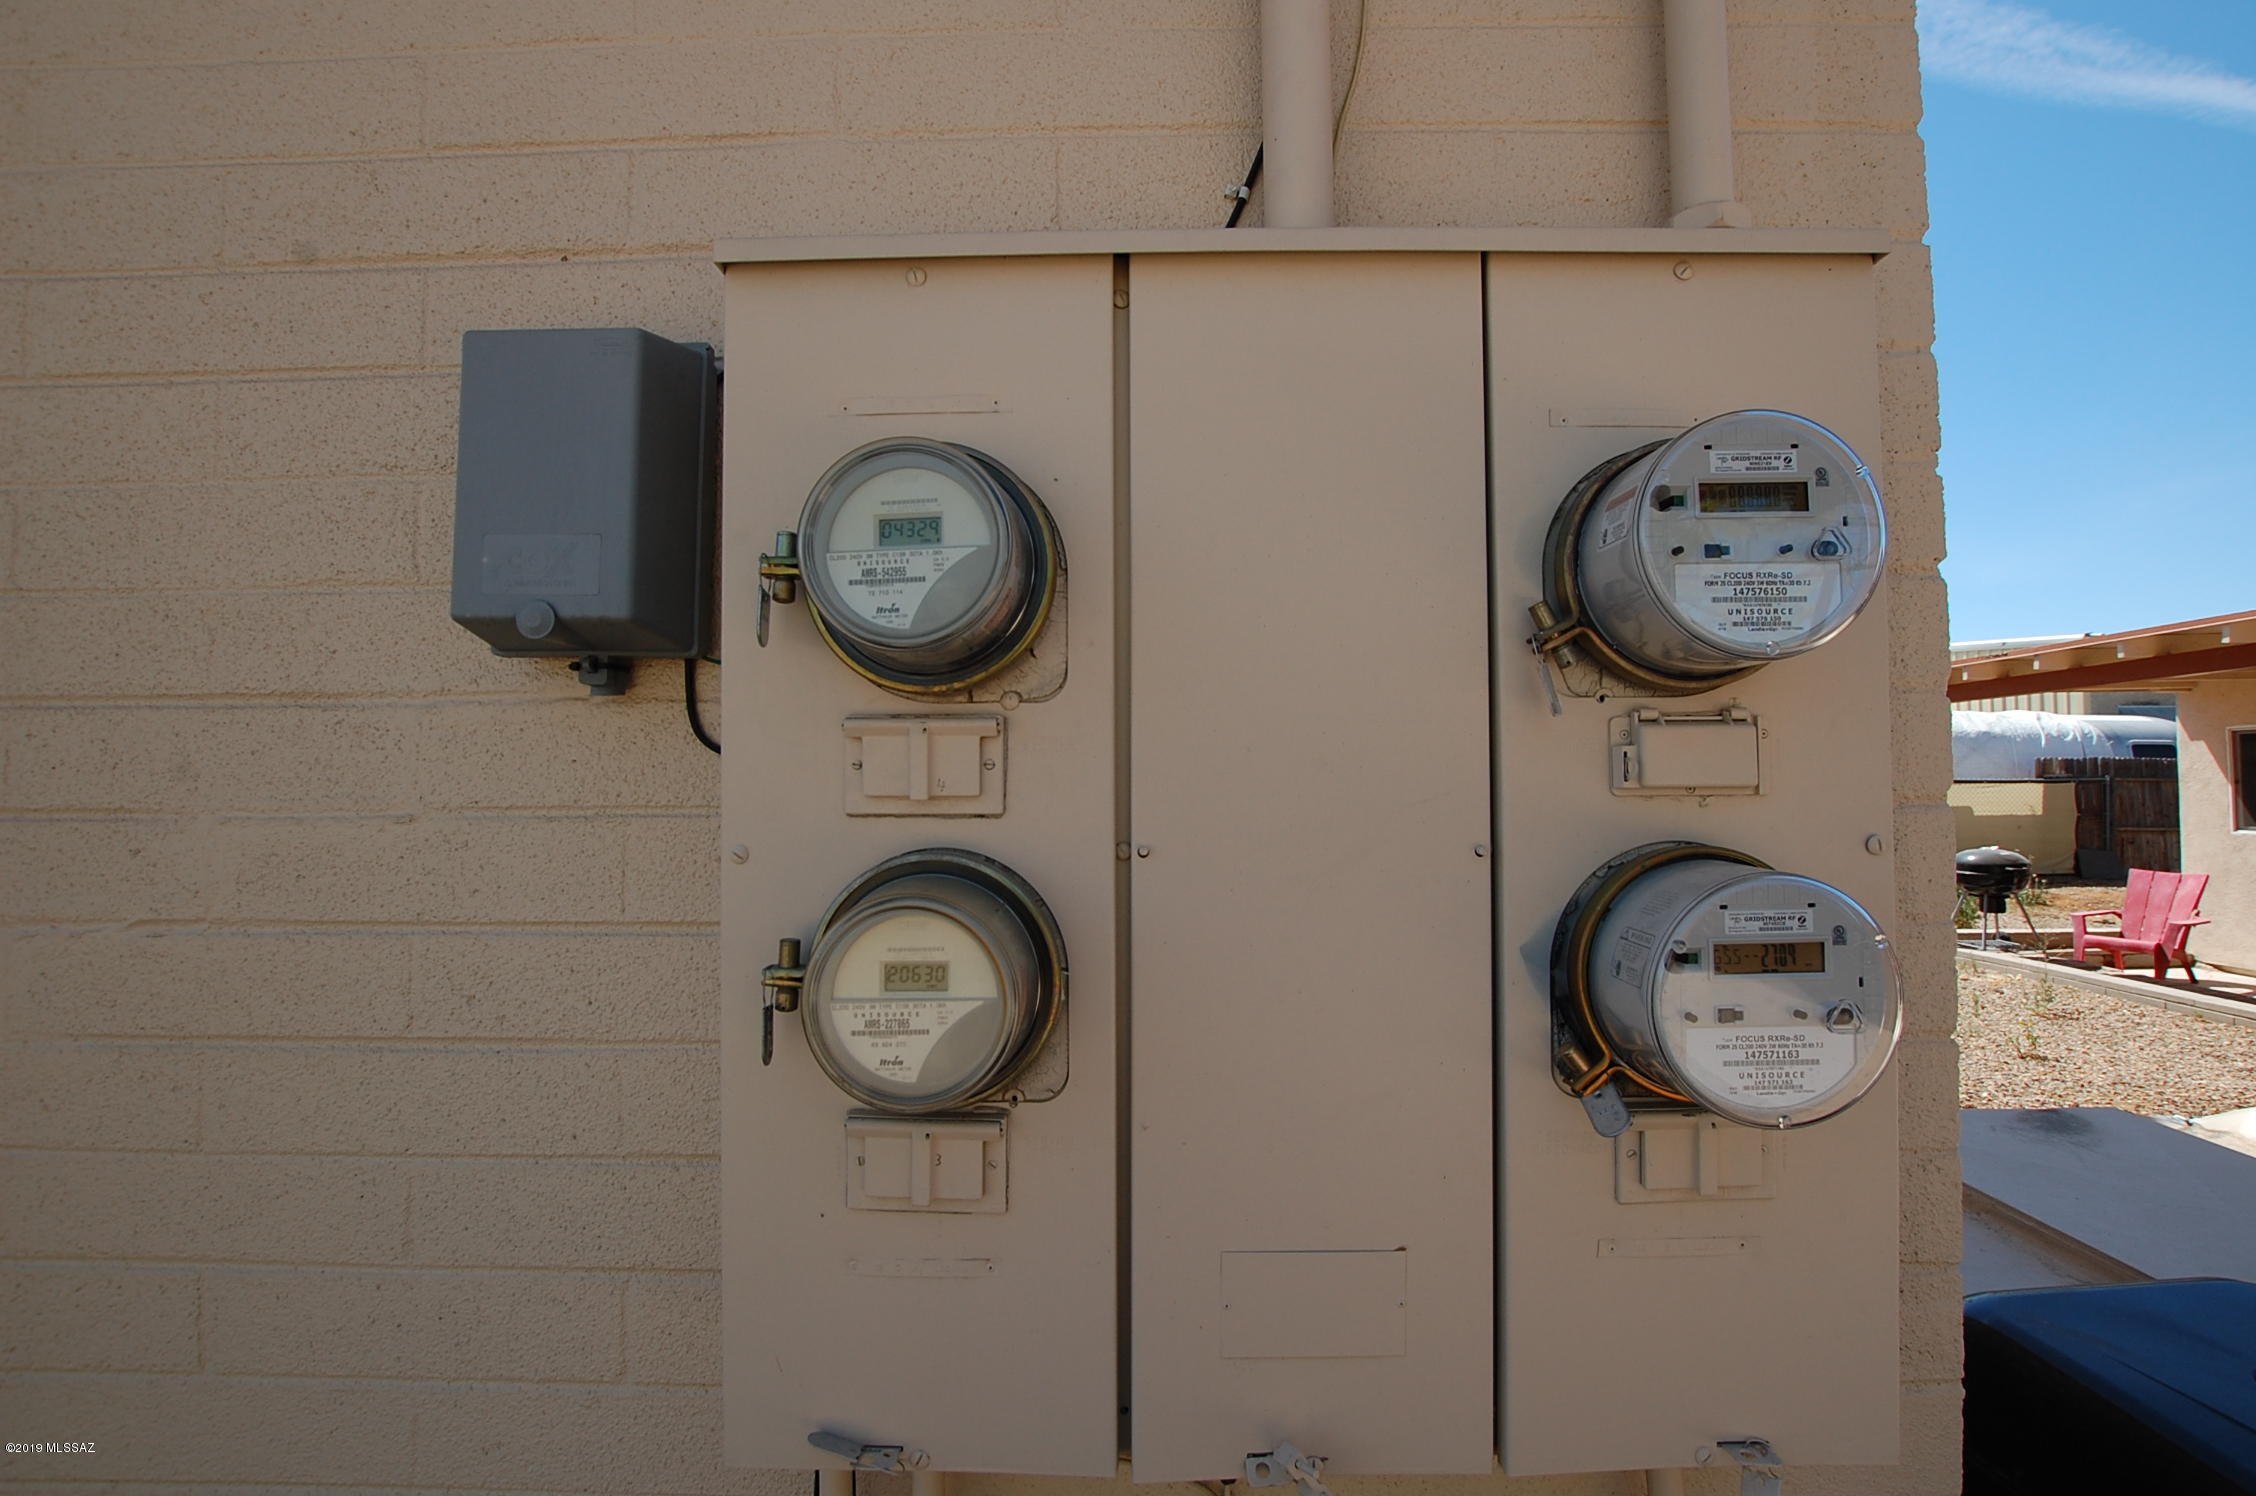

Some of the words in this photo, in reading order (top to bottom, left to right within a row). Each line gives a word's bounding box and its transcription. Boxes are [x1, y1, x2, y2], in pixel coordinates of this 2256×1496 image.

[882, 520, 939, 539] 04329
[1723, 572, 1754, 580] FOCUS
[1733, 587, 1788, 596] 147576150
[1727, 608, 1793, 616] UNISOURCE
[1735, 1035, 1766, 1043] FOCUS
[1744, 1050, 1800, 1060] 147571163
[1739, 1071, 1806, 1079] UNISOURCE
